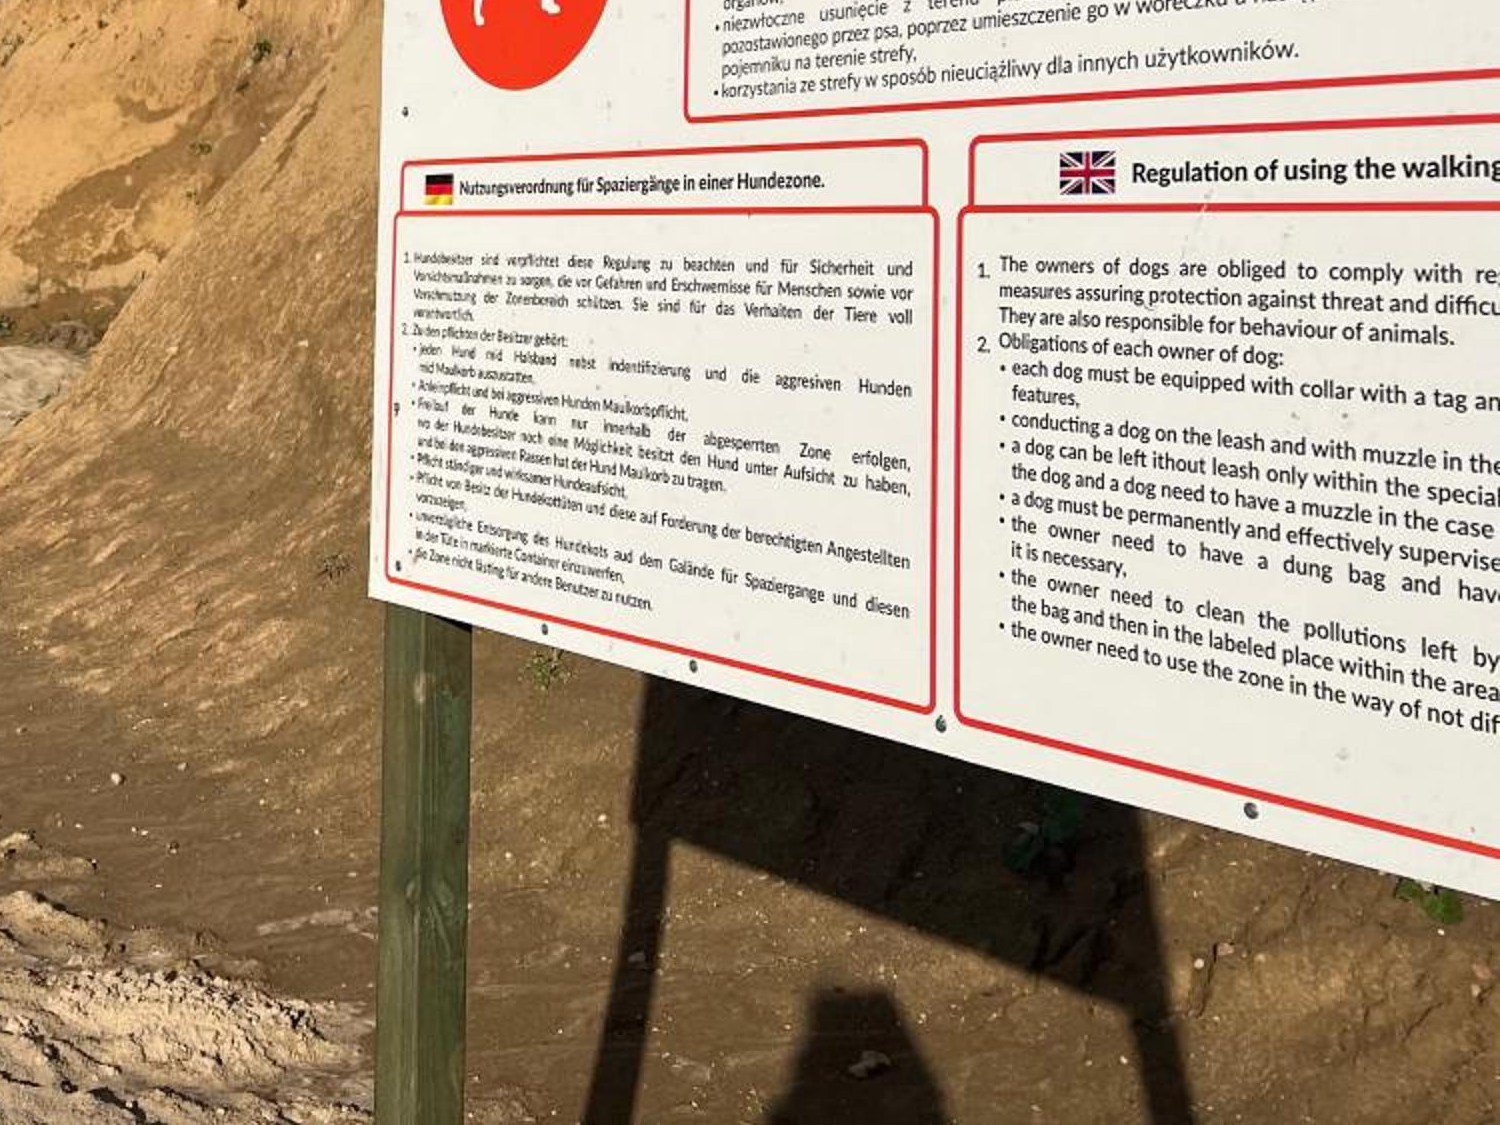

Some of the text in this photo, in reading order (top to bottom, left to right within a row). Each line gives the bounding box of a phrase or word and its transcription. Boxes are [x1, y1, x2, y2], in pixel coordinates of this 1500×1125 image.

[903, 0, 912, 14] z
[721, 55, 791, 80] pojemniku
[795, 56, 811, 70] na
[815, 48, 867, 70] terenie
[721, 38, 1299, 100] korzystania ze strefy w sposób nieuciążliwy dla innych użytkowników.
[576, 176, 595, 194] für
[595, 174, 681, 196] Spaziergänge
[683, 174, 696, 192] in
[698, 172, 735, 191] einer
[737, 170, 825, 190] Hundezone.
[1131, 160, 1249, 188] Regulation
[1253, 158, 1279, 182] of
[1283, 157, 1349, 186] using
[1353, 156, 1397, 180] the
[999, 254, 1029, 273] The
[1035, 260, 1095, 275] owners
[1102, 256, 1122, 276] of
[1128, 256, 1170, 280] dogs
[1178, 262, 1208, 278] are
[1217, 258, 1286, 283] obliged
[1297, 261, 1318, 281] to
[1328, 261, 1404, 286] comply
[1413, 262, 1463, 284] with
[1475, 268, 1500, 289] re
[999, 284, 1072, 300] measures
[1075, 284, 1146, 309] assuring
[1148, 286, 1243, 307] protection
[1247, 289, 1317, 312] against
[1321, 290, 1384, 312] threat
[1389, 292, 1429, 315] and
[999, 306, 1455, 346] They are also responsible for behaviour of animals.
[977, 331, 1284, 370] 2. Obligations of each owner of dog:
[705, 366, 727, 382] und
[741, 368, 761, 384] die
[858, 378, 913, 398] Hunden
[1011, 360, 1049, 378] each
[1052, 360, 1083, 384] dog
[1087, 366, 1130, 384] must
[1133, 366, 1156, 386] be
[1160, 370, 1246, 394] equipped
[1250, 374, 1294, 396] with
[1299, 379, 1356, 401] collar
[1359, 382, 1407, 405] with
[1413, 390, 1427, 406] a
[1432, 388, 1469, 414] tag
[1011, 492, 1021, 506] a
[1023, 490, 1054, 514] dog
[1057, 498, 1099, 518] must
[1102, 499, 1124, 521] be
[1127, 508, 1241, 540] permanently
[1245, 522, 1281, 543] and
[1285, 526, 1394, 562] effectively
[1011, 593, 1500, 704] the bag and then in the labeled place within the area
